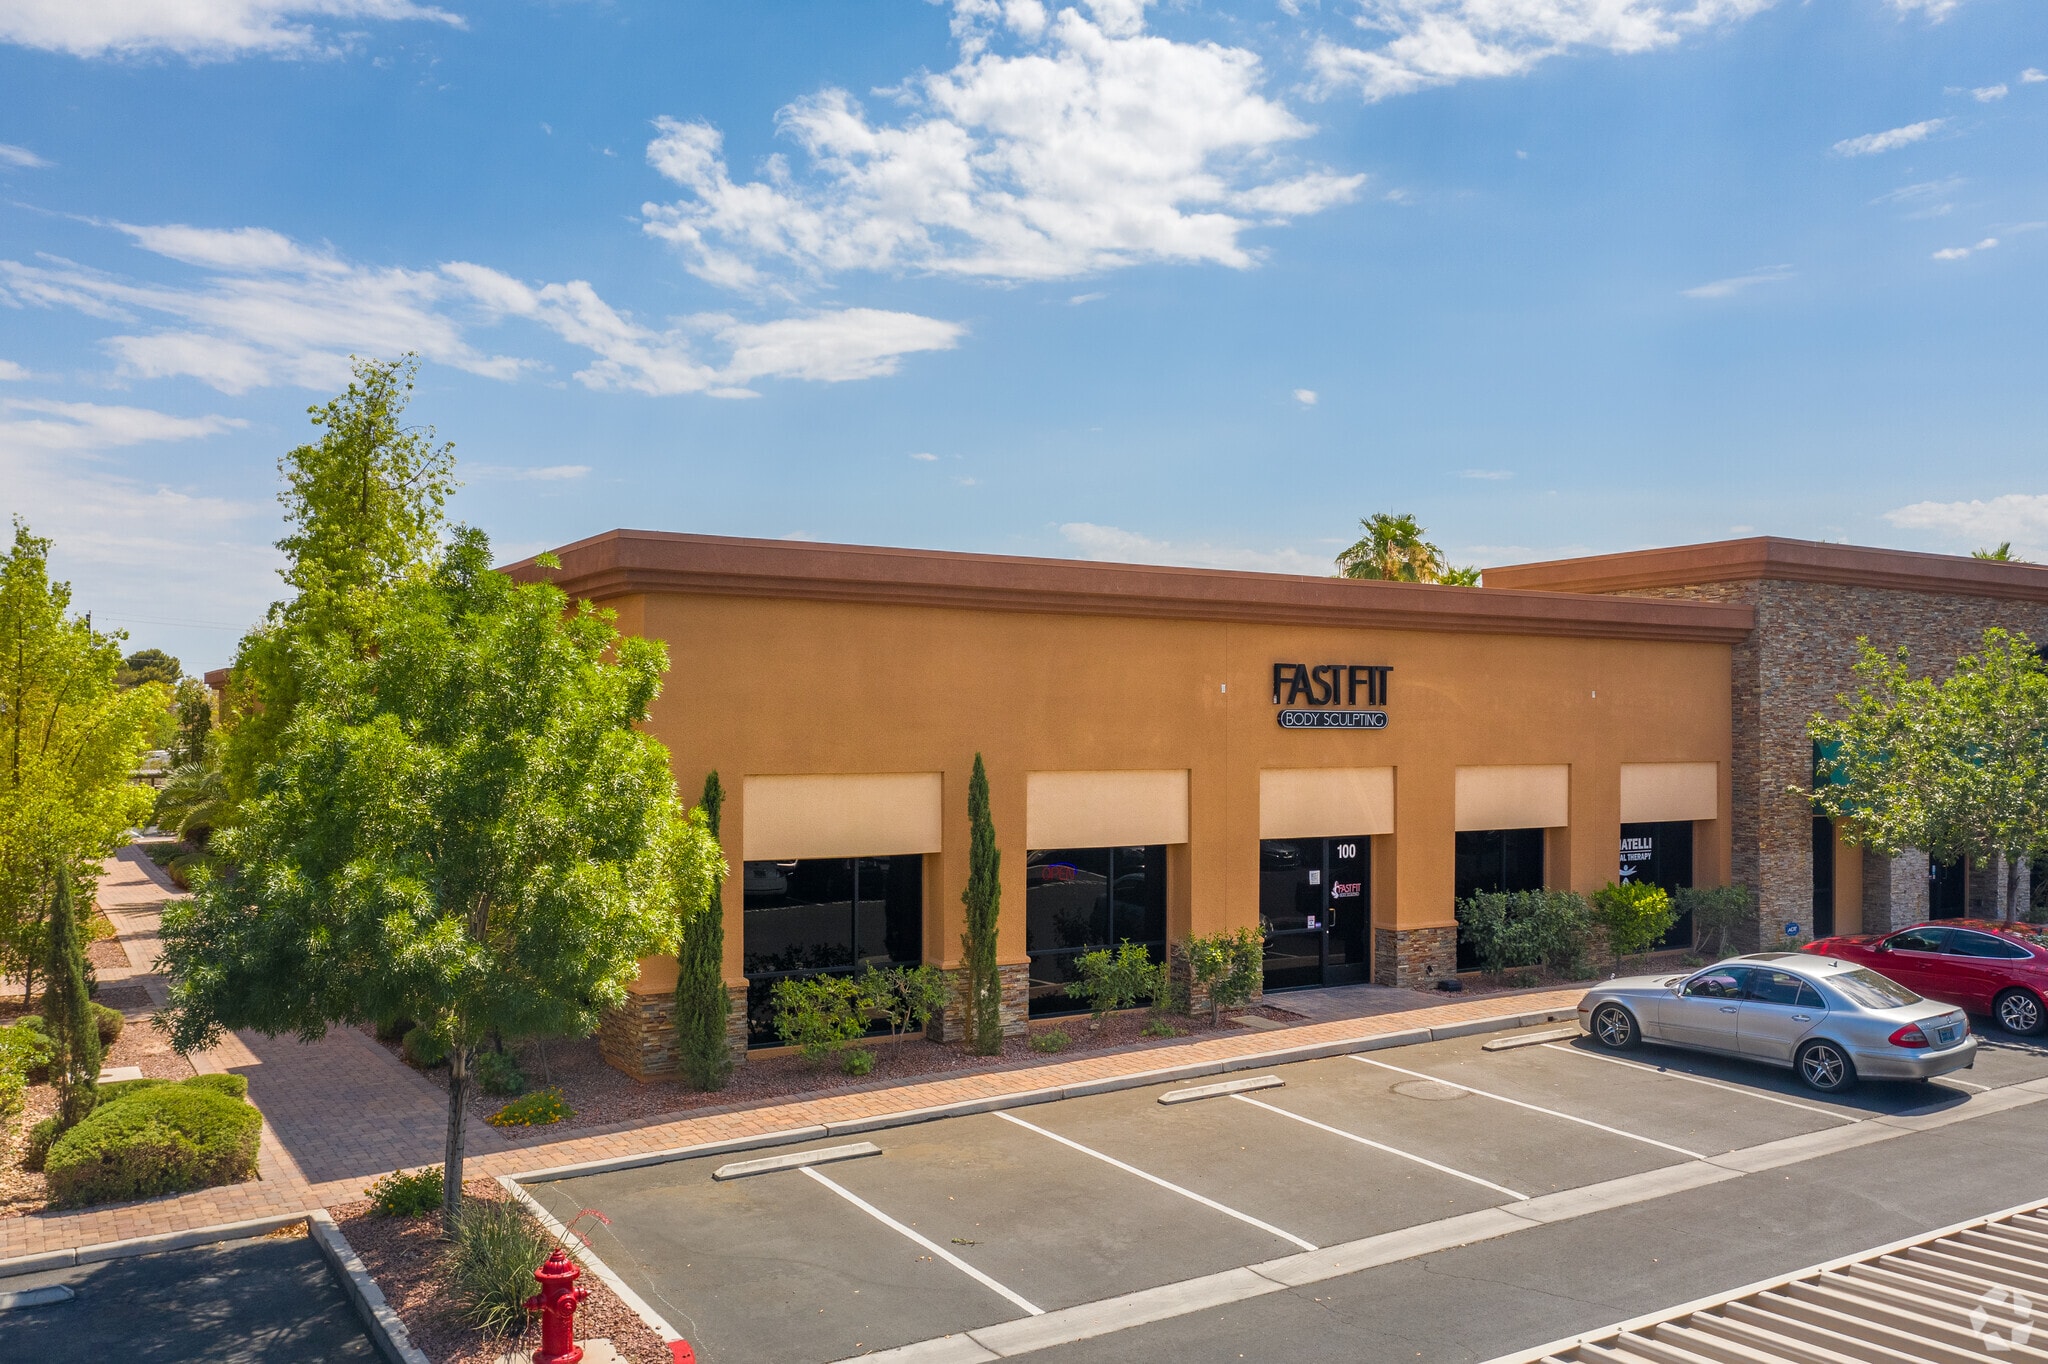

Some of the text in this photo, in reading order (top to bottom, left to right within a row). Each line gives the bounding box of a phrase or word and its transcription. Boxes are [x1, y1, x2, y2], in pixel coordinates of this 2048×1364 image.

[1273, 663, 1394, 706] FAST FIT
[1286, 712, 1384, 727] BODY SCULPTING
[1337, 844, 1356, 858] 100
[1620, 838, 1652, 850] ATELLI
[1627, 853, 1651, 861] THERAPY
[1042, 866, 1075, 880] OPEN
